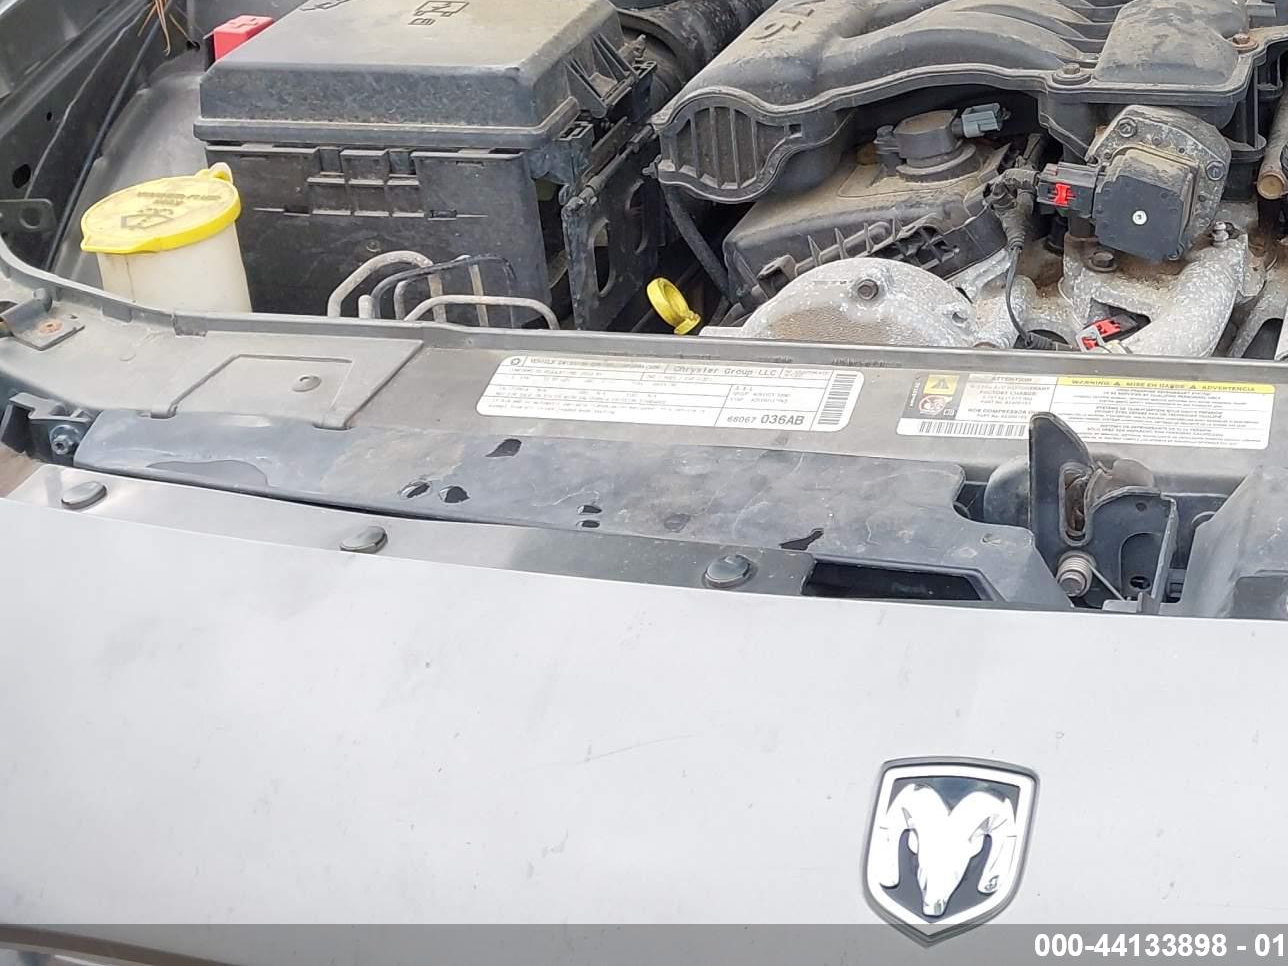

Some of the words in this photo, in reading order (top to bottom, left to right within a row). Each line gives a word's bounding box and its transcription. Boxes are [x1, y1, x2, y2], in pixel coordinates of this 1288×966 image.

[673, 365, 719, 376] Chrysler
[723, 367, 754, 378] Group
[757, 368, 778, 377] LLC
[1201, 384, 1256, 392] ADVERTENCIA
[760, 413, 805, 426] 036AB
